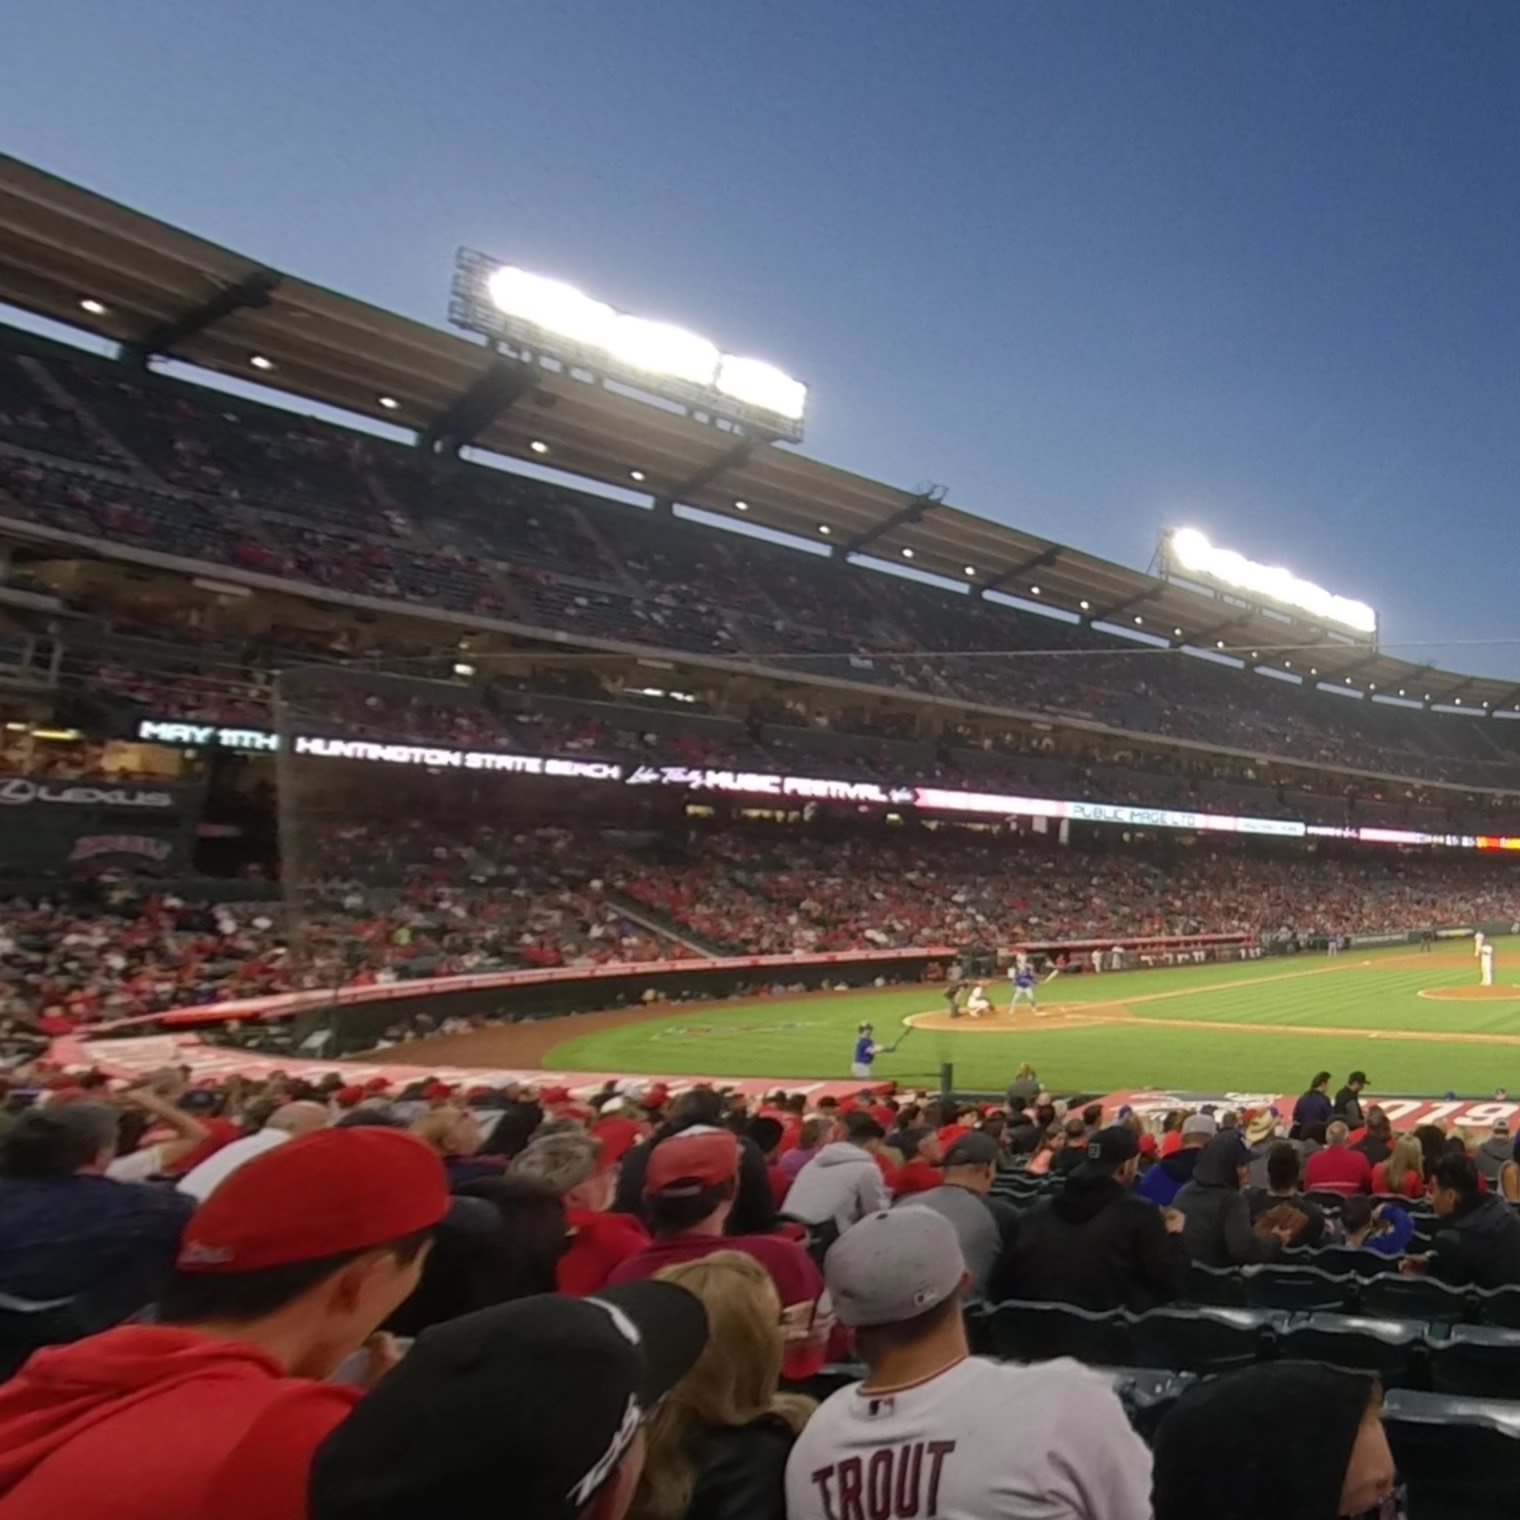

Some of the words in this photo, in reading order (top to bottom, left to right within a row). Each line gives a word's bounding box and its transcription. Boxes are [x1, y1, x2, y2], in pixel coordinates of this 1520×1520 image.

[138, 719, 214, 743] MAY
[217, 727, 280, 750] 11TH
[295, 737, 461, 767] HUNTINGTON
[463, 752, 541, 773] STATE
[545, 759, 621, 780] BEACH
[705, 769, 782, 794] MUSIC
[783, 776, 888, 802] FESTIVAL
[37, 785, 173, 807] LEXUS
[1073, 804, 1123, 821] PUBLIC
[1129, 809, 1168, 825] IMAGE
[1172, 813, 1196, 826] LTD
[811, 1439, 957, 1520] TROUT
